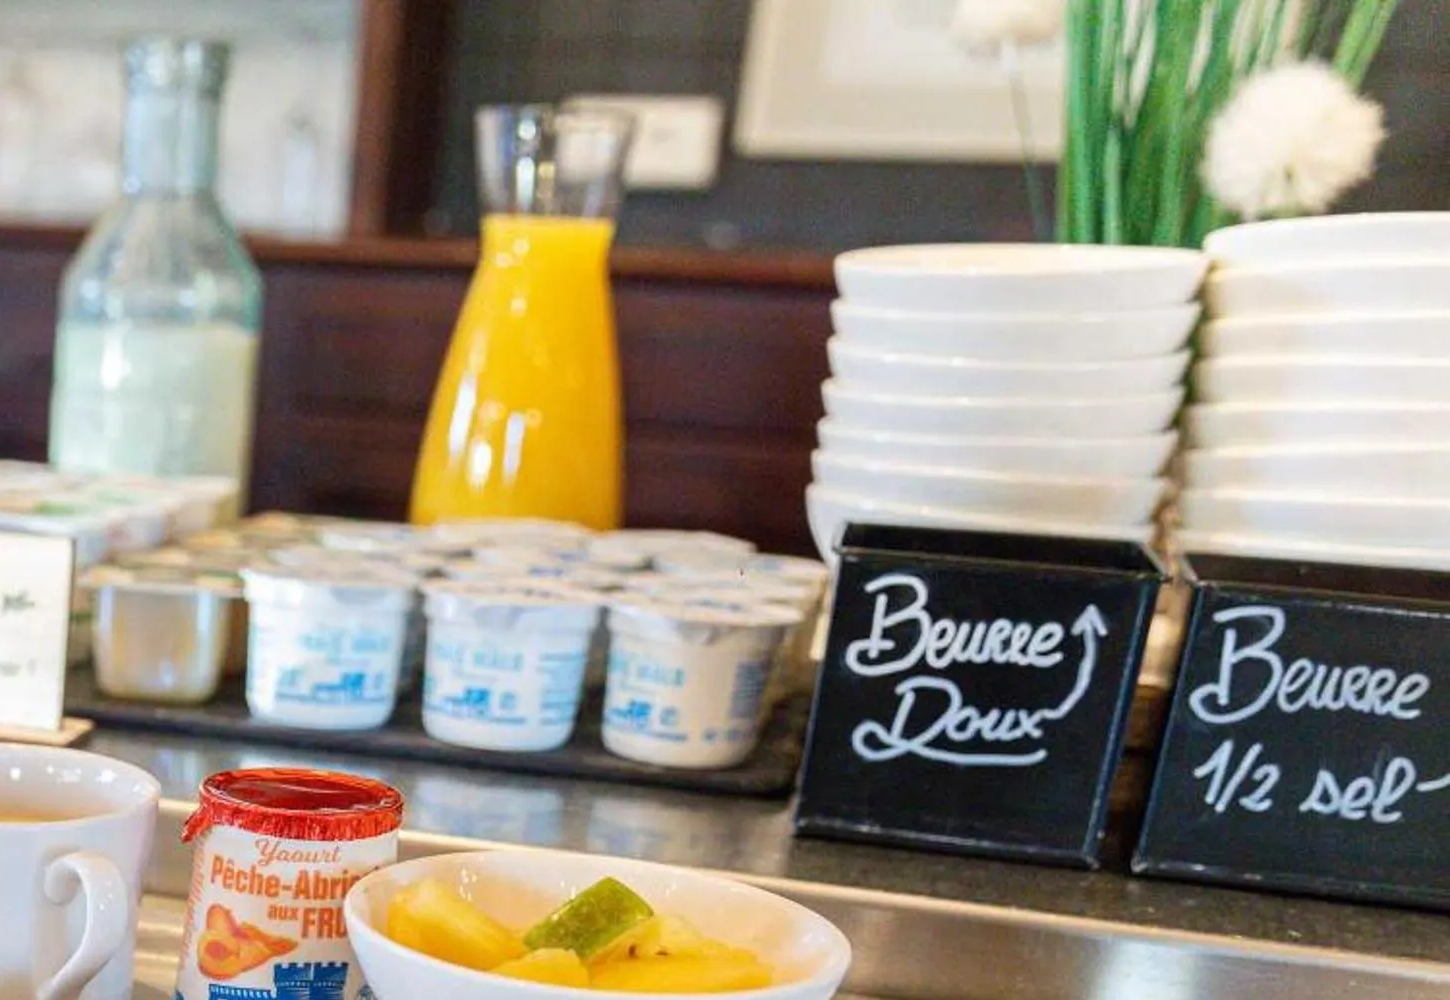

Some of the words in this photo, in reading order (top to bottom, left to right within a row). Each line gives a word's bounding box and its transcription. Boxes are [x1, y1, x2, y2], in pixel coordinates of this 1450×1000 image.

[852, 675, 1048, 766] Doux
[1193, 739, 1281, 813] 1/2
[254, 837, 343, 867] Yaourt
[267, 903, 299, 921] aux
